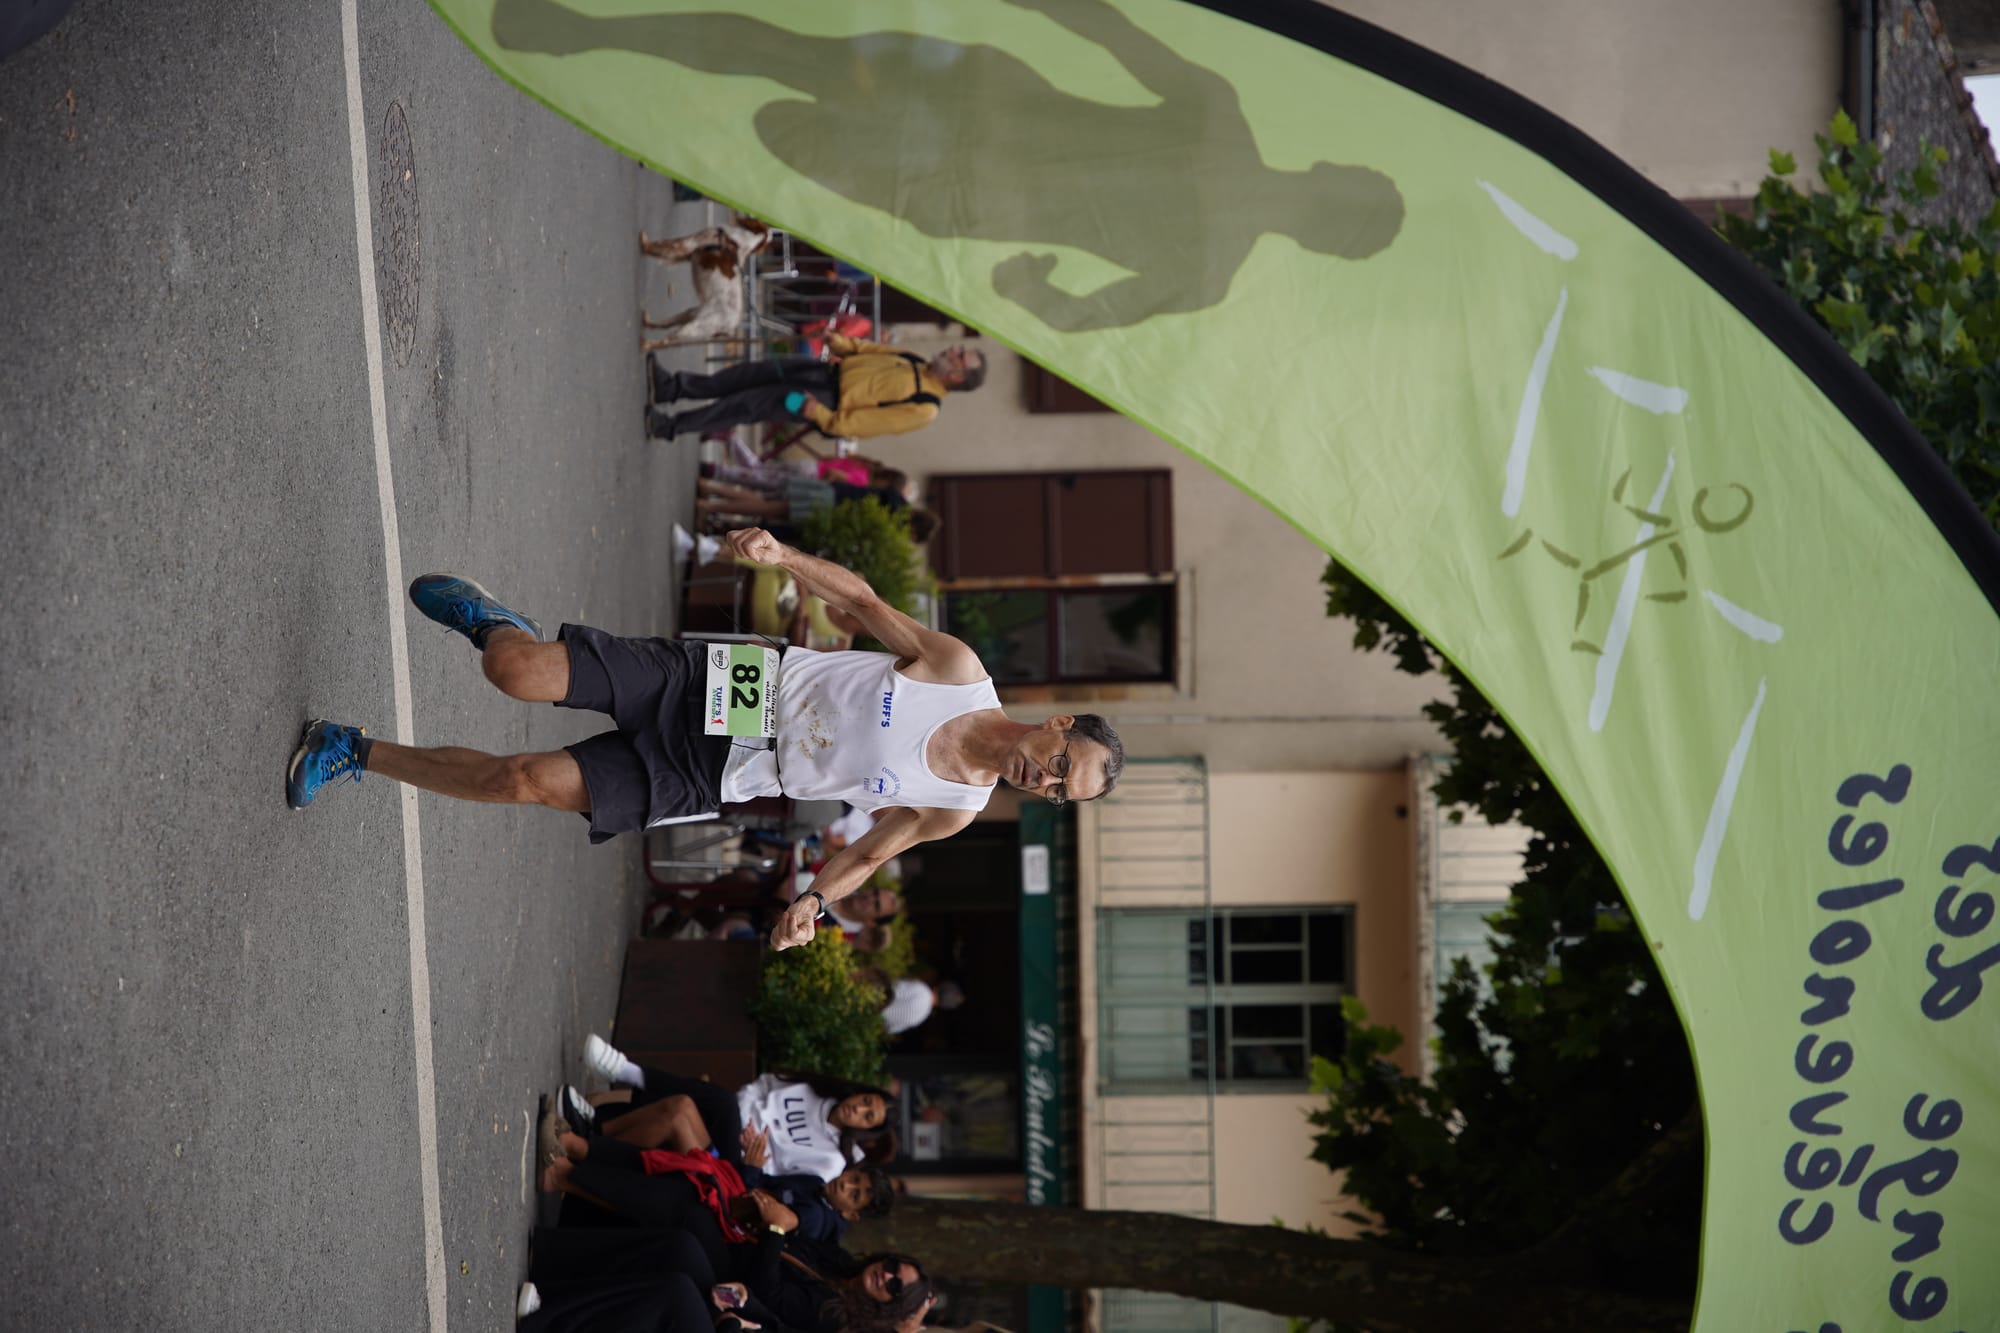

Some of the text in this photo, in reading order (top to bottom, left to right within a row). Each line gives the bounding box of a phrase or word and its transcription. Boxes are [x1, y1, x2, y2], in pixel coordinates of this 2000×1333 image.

[730, 663, 761, 709] 82
[769, 684, 778, 715] Challenge
[881, 691, 893, 728] TUFF'S
[784, 1097, 813, 1147] LULU
[1025, 1019, 1056, 1205] Le Boulodro
